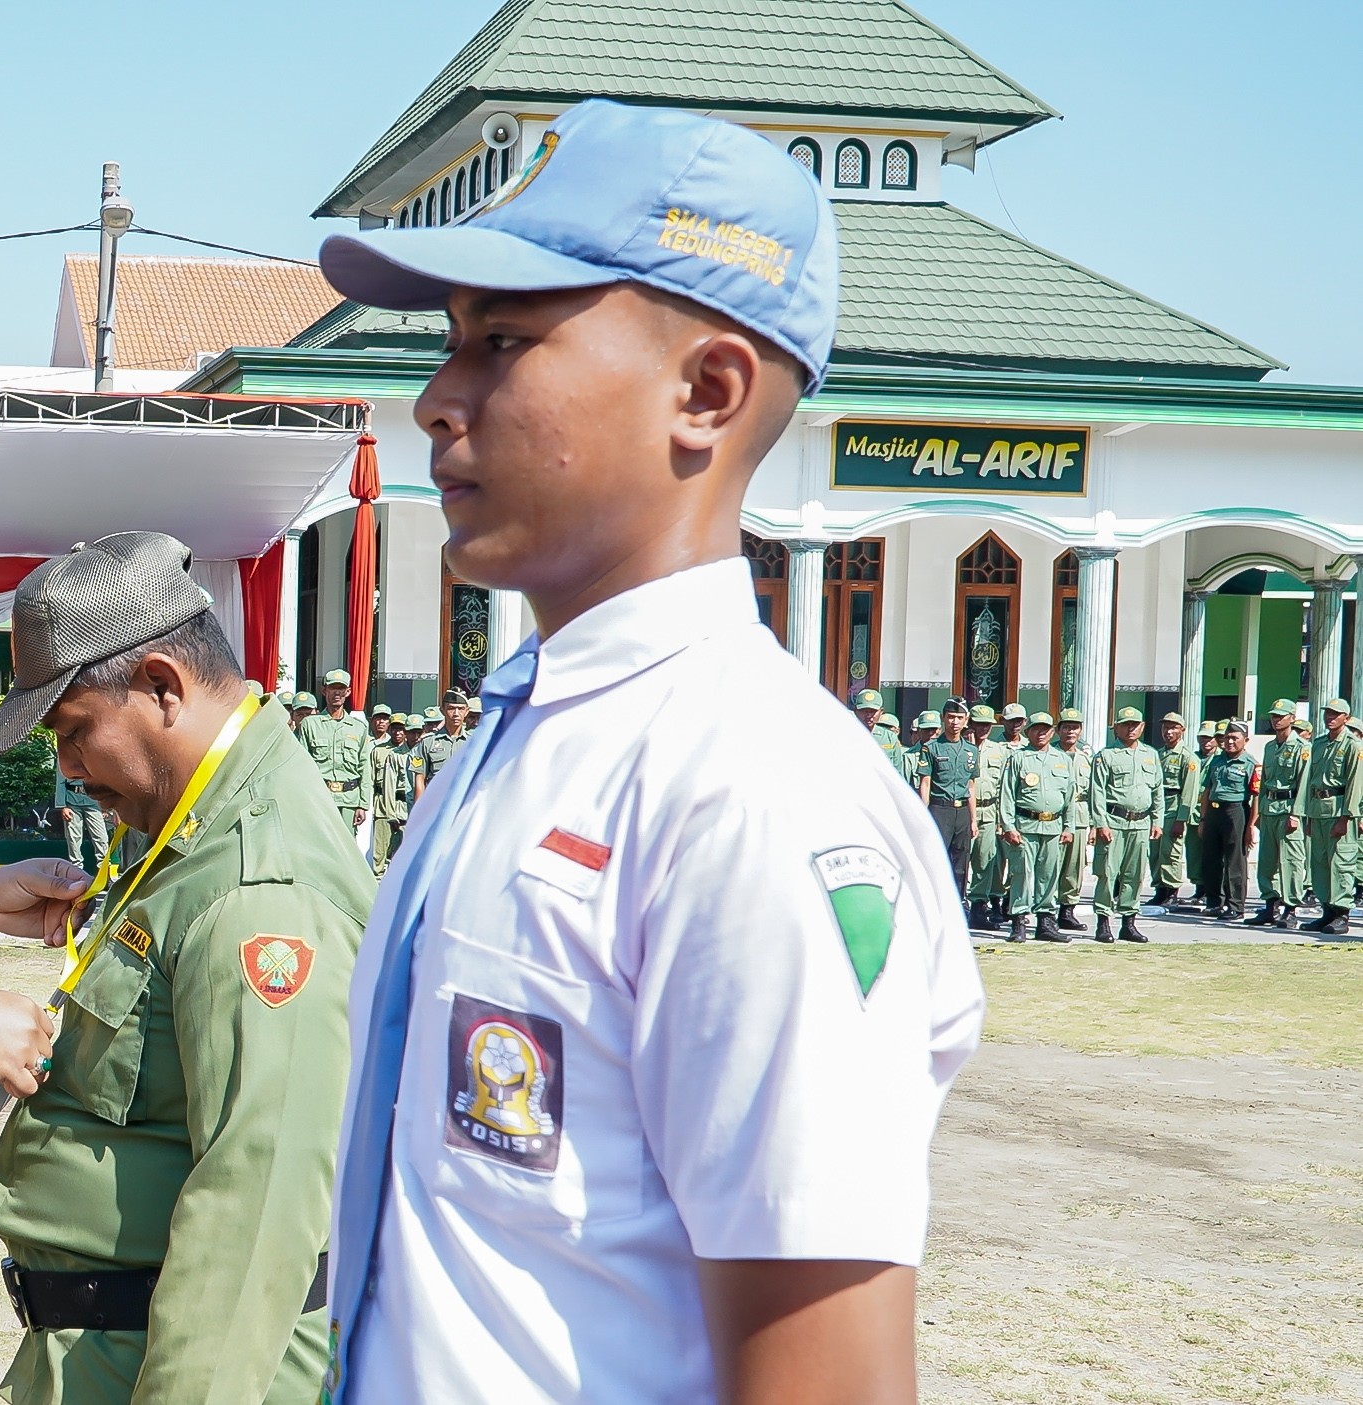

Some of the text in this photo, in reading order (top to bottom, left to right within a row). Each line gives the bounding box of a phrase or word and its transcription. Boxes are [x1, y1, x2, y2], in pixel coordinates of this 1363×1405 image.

[657, 227, 786, 286] KEDUNGPRING
[664, 207, 710, 235] SMA
[713, 221, 783, 261] NEGERI
[845, 435, 1081, 480] Masjid AL-ARIF
[118, 921, 147, 952] LINMAS
[471, 1123, 527, 1154] OSIS
